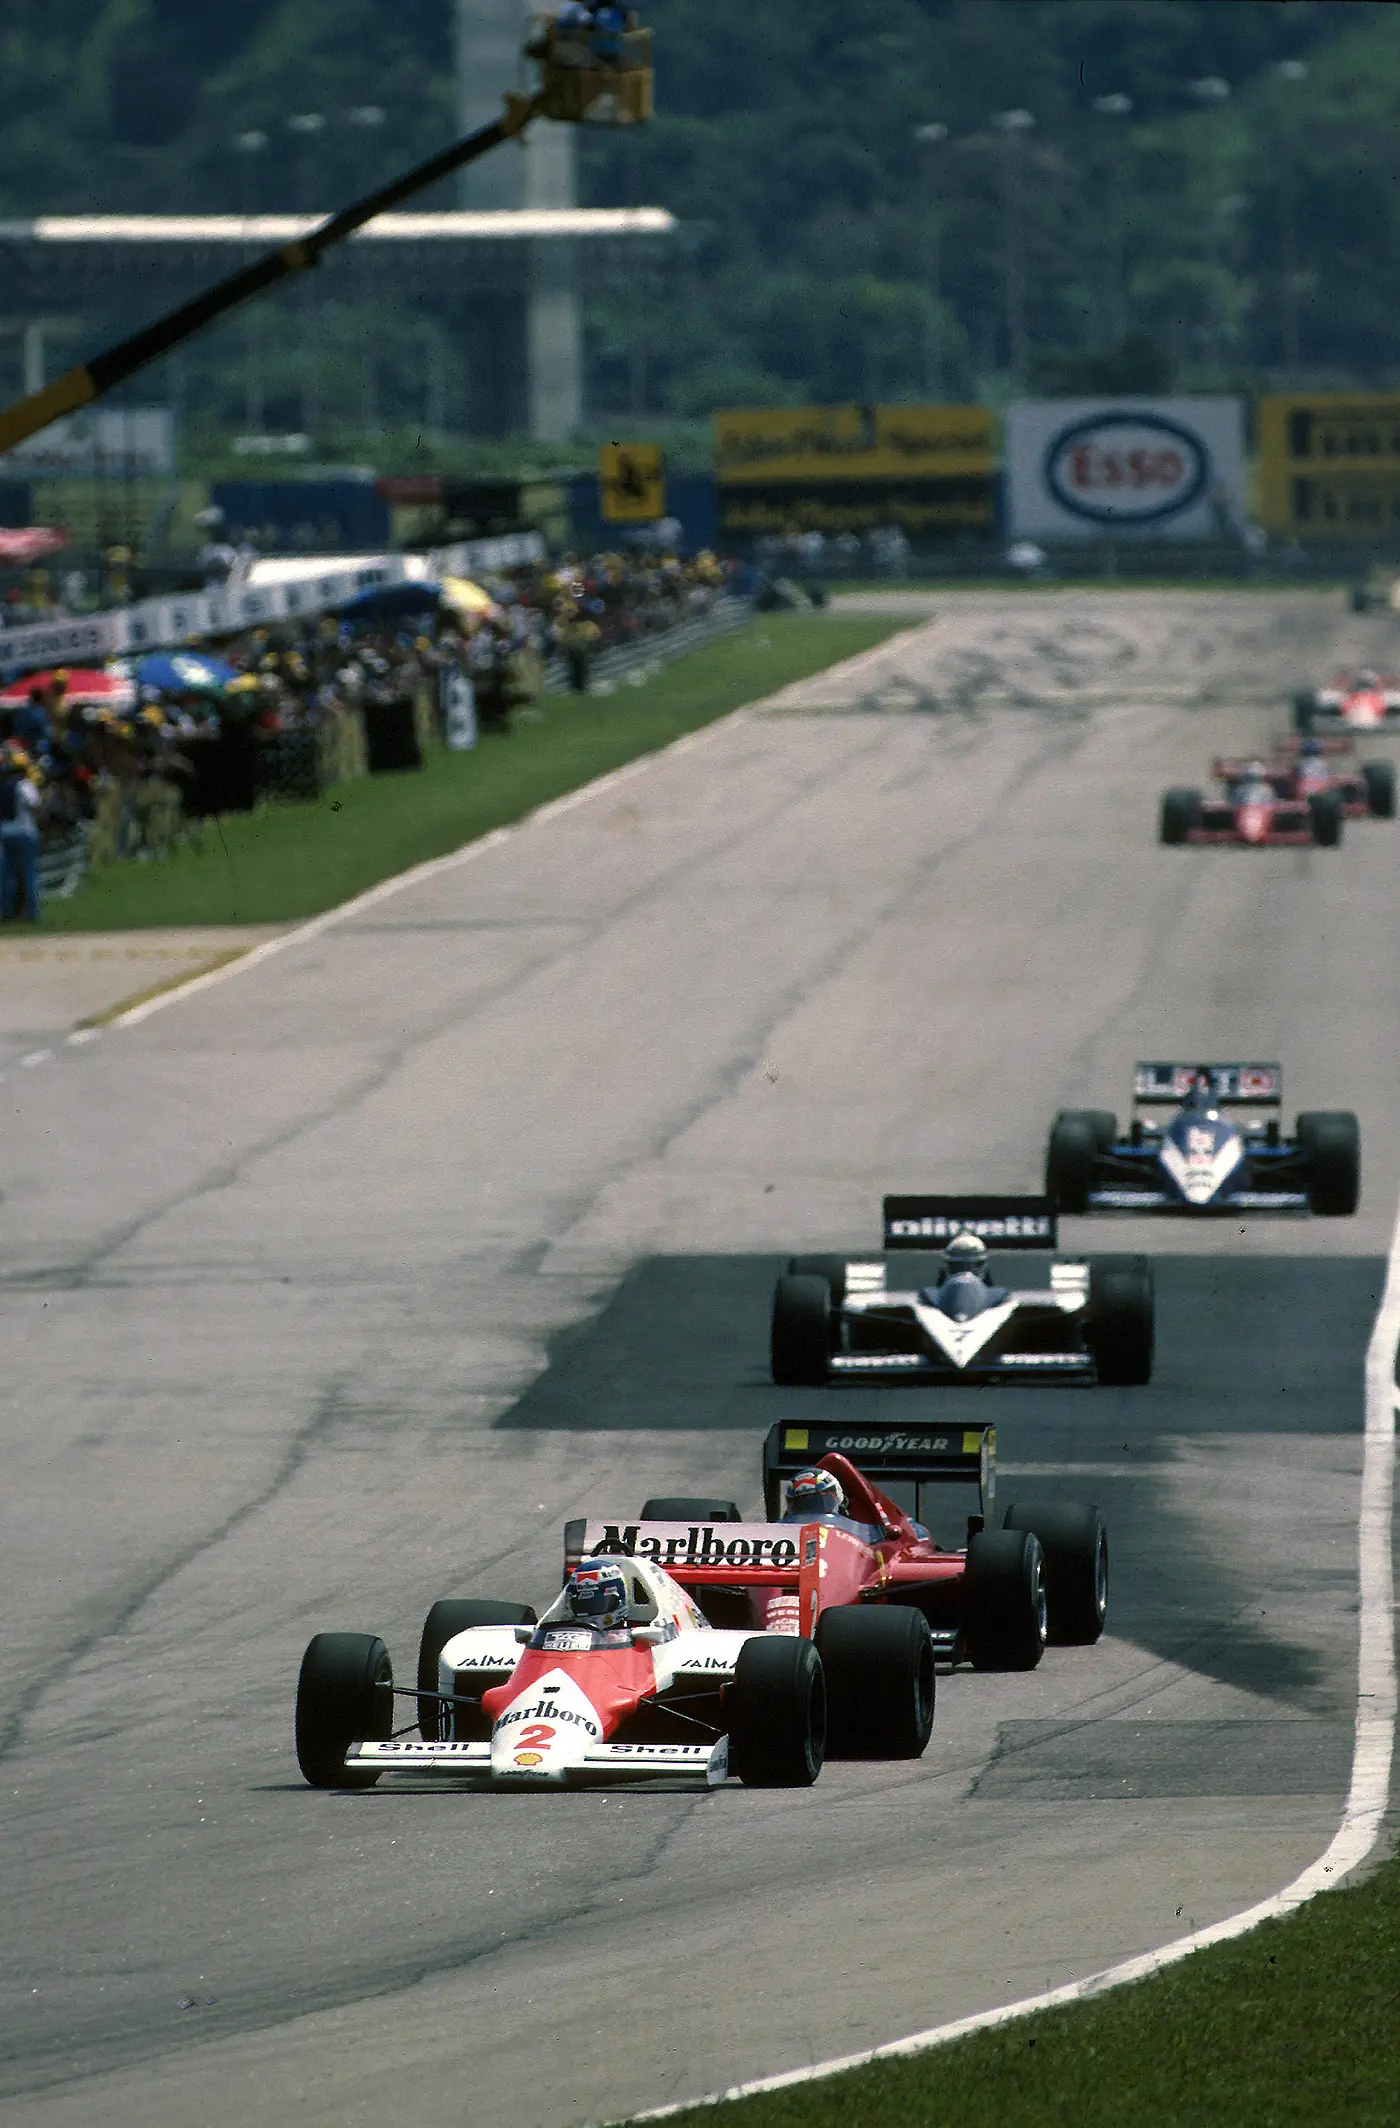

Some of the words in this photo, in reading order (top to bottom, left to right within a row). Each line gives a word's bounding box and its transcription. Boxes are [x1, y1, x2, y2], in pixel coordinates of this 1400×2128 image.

[825, 1433, 949, 1452] GOODYEAR
[603, 1525, 797, 1567] Marlboro
[494, 1700, 597, 1736] Marlboro
[377, 1743, 470, 1751] Shell
[513, 1724, 557, 1750] 2
[610, 1745, 701, 1754] Shell
